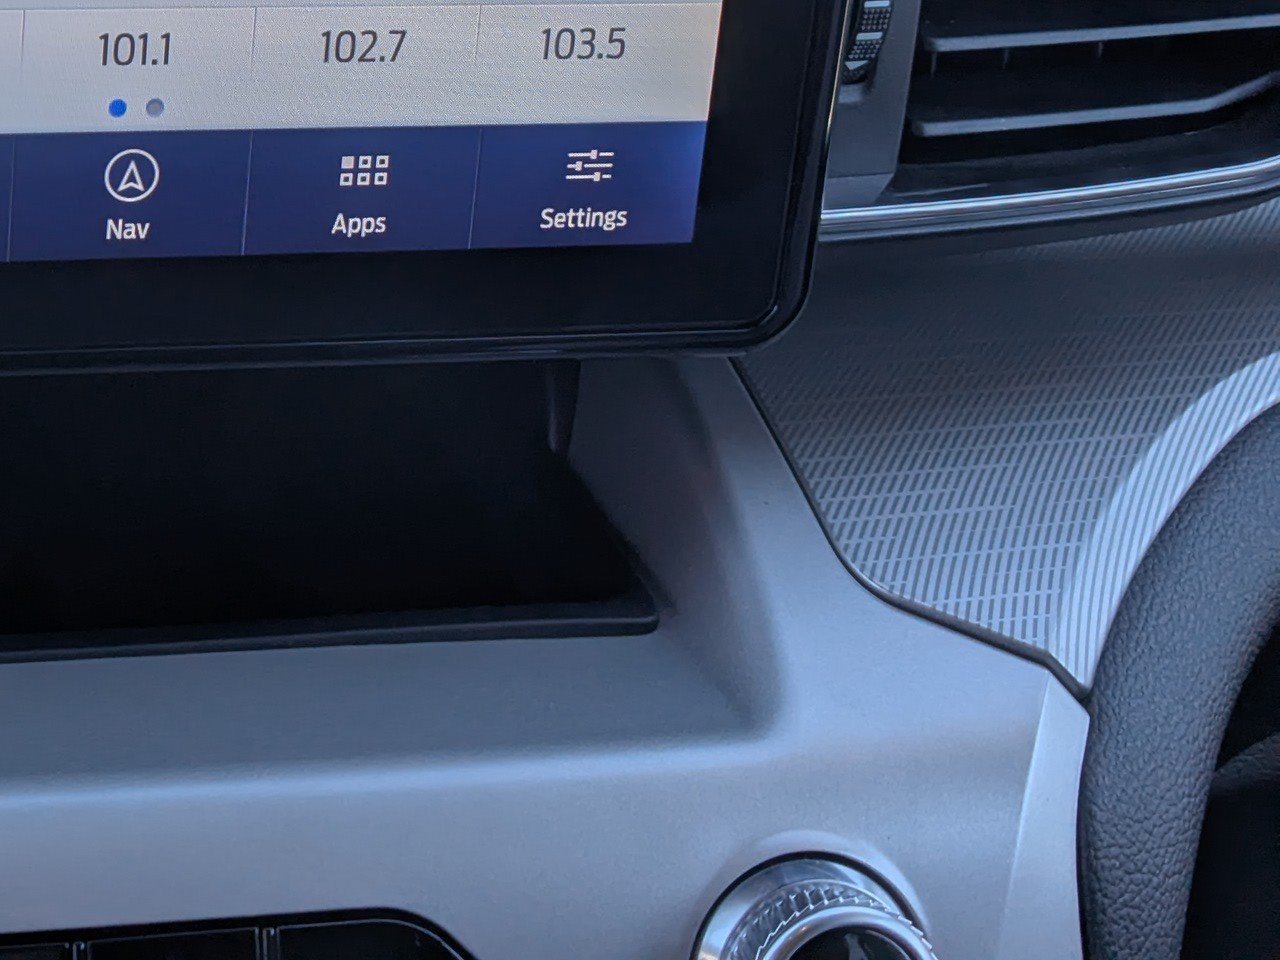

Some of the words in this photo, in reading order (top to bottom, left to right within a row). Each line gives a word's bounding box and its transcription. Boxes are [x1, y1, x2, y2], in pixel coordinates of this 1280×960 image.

[99, 31, 171, 66] 101.1
[321, 30, 407, 64] 102.7
[541, 27, 626, 60] 103.5
[106, 219, 150, 241] Nav
[331, 212, 386, 239] Apps
[540, 206, 628, 232] Settings
